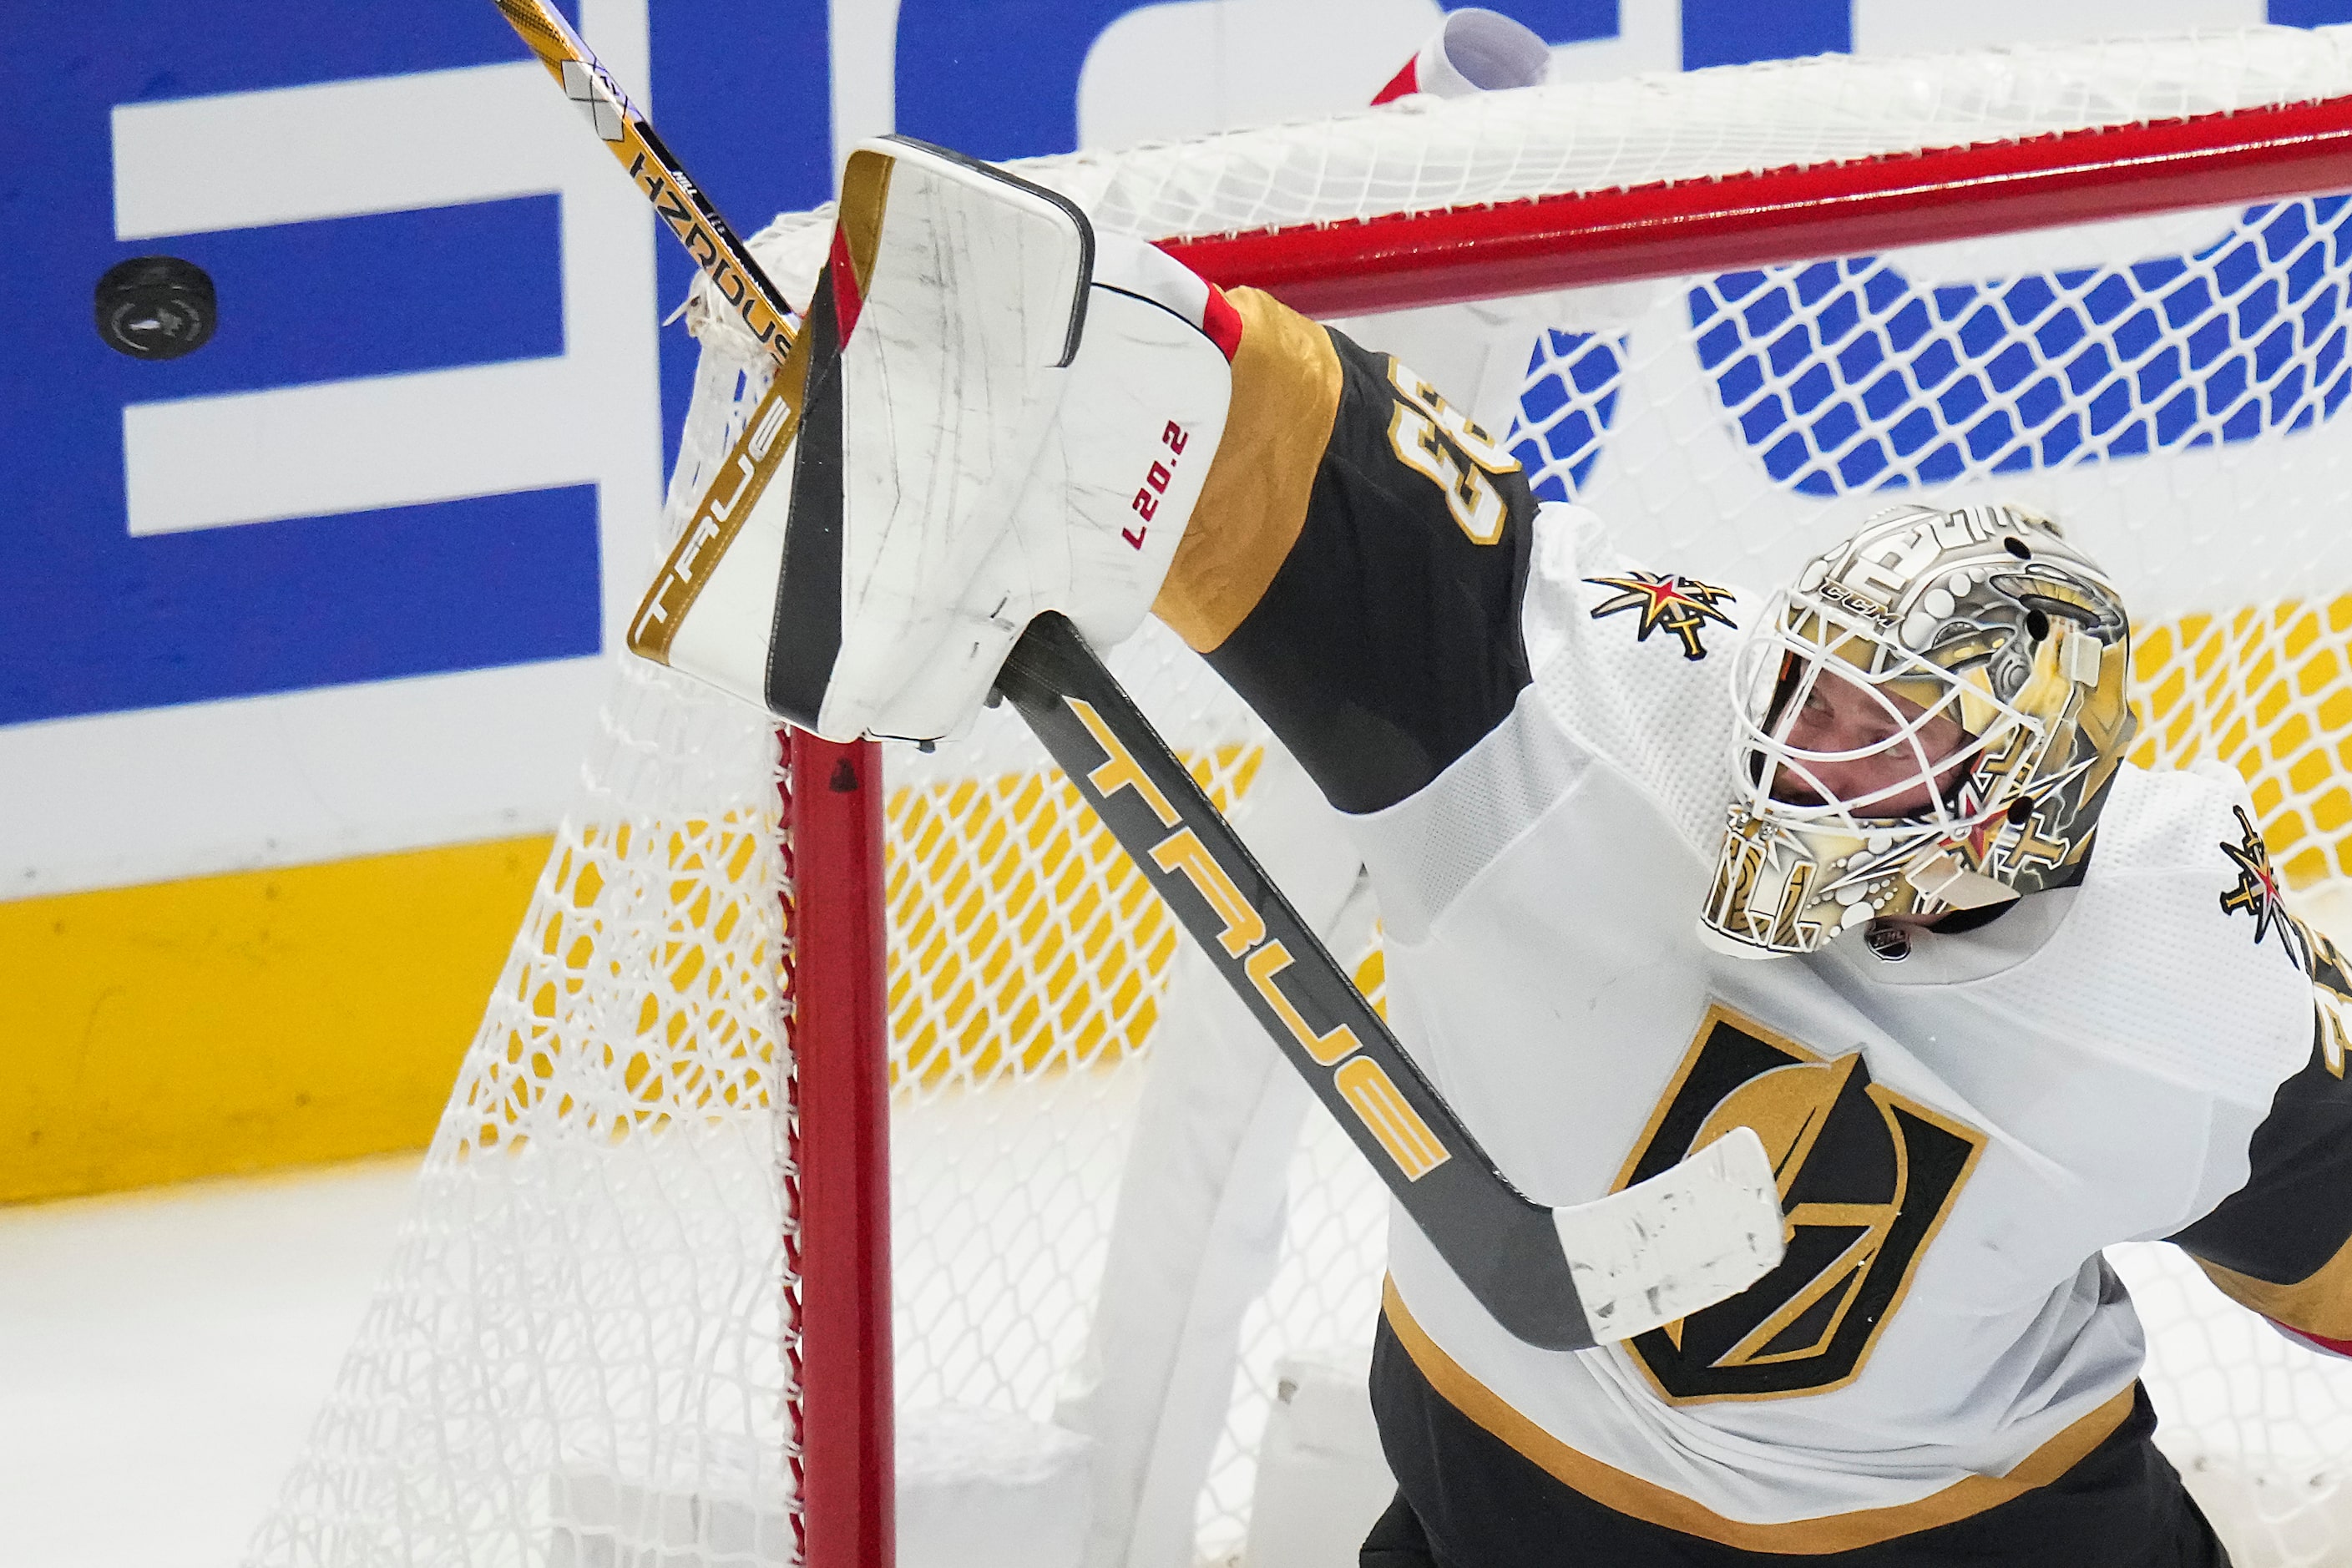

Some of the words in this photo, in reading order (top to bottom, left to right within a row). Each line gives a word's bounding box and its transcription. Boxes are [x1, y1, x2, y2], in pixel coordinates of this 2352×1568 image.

[630, 152, 792, 367] HZRDUS
[635, 395, 792, 645] TRUE
[1121, 420, 1189, 550] L20.2
[1818, 577, 1905, 629] CCM
[1061, 695, 1452, 1182] TRUE
